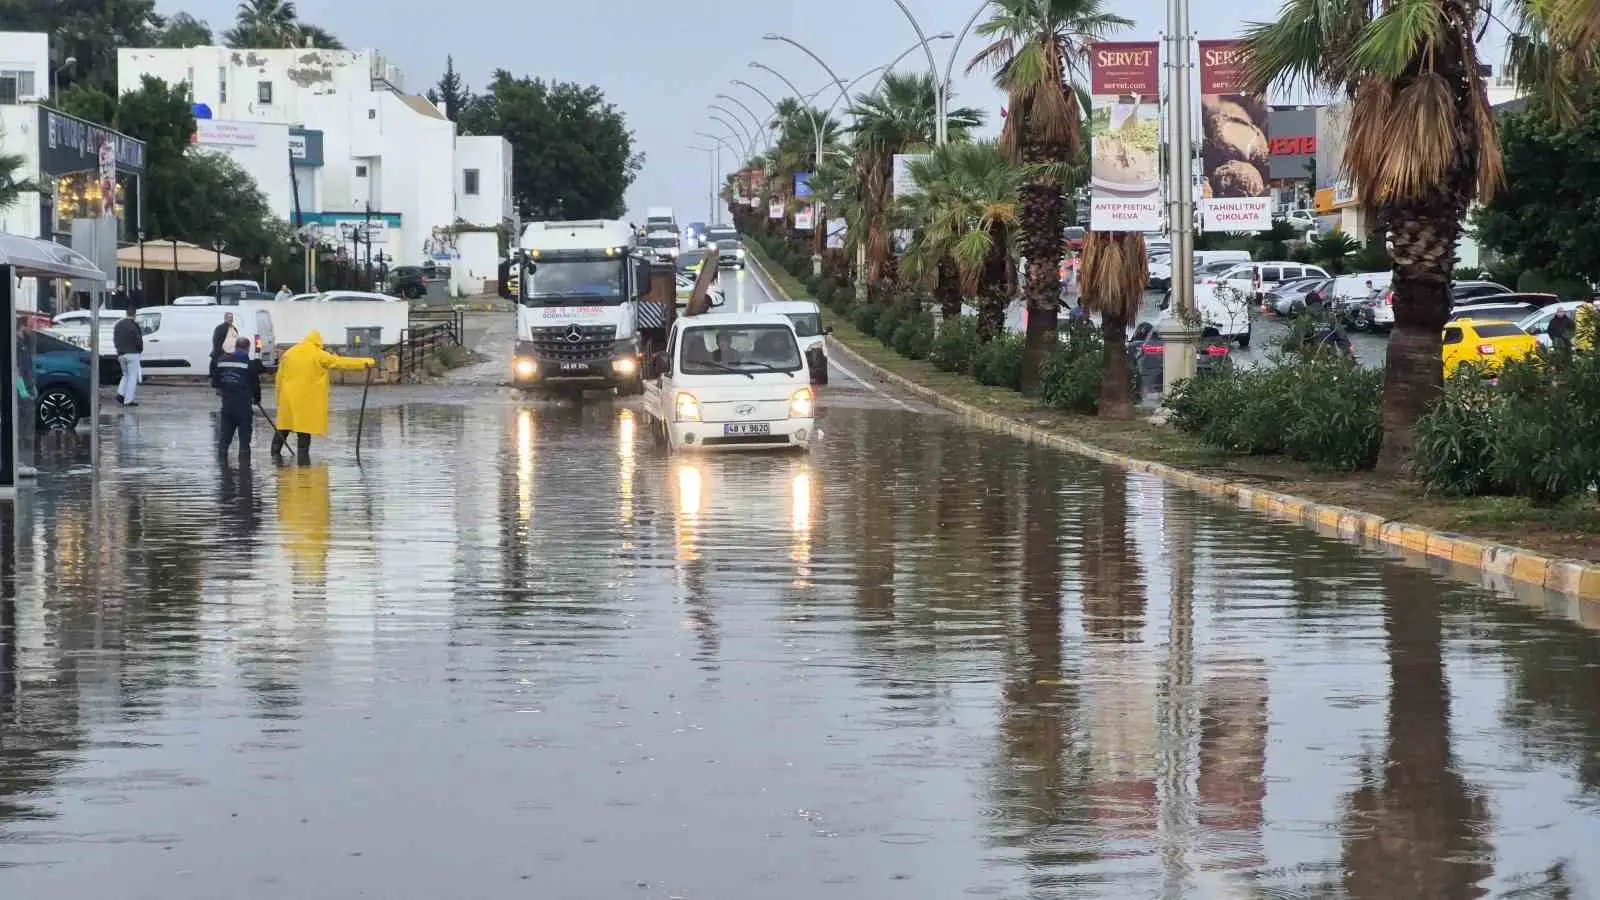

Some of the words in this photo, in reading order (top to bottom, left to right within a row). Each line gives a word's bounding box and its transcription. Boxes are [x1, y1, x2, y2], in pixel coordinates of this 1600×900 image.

[1098, 50, 1152, 67] SERVET
[1095, 203, 1122, 211] ANTEP
[1112, 212, 1139, 220] HELVA
